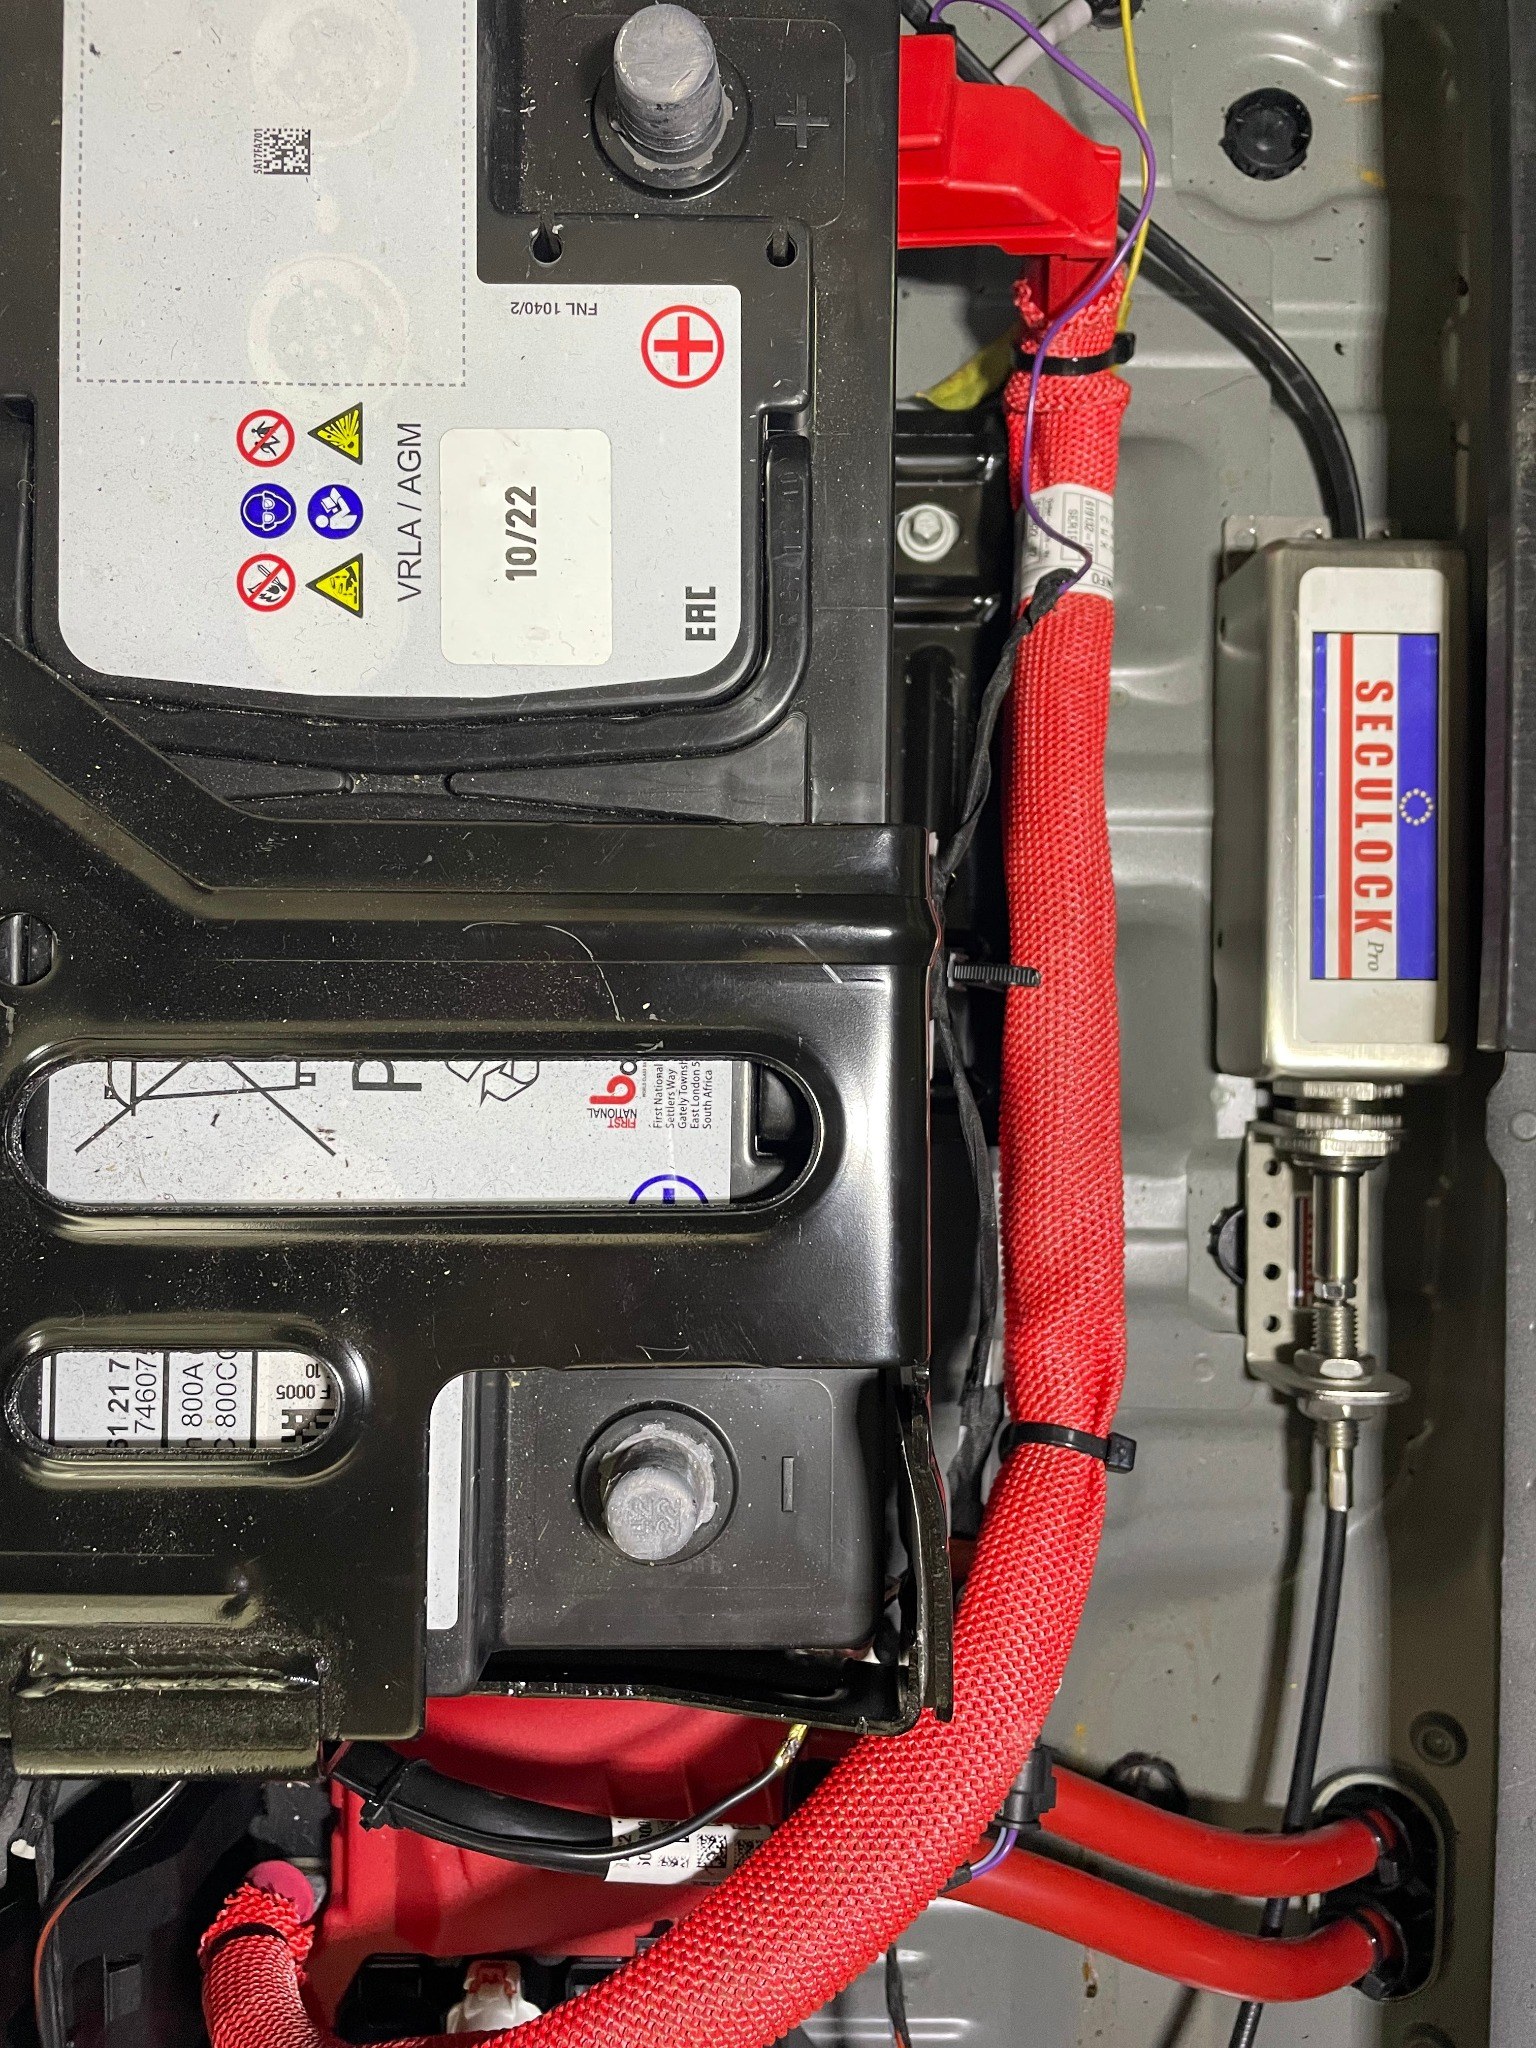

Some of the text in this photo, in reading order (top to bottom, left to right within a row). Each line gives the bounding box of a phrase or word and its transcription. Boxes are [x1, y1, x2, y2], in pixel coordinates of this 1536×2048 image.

[253, 128, 263, 175] 5A17FA701
[510, 301, 598, 316] FNL 1040/2
[397, 423, 422, 496] AGM
[504, 485, 537, 582] 10/22
[397, 518, 422, 603] VRLA
[685, 585, 717, 642] EAC
[1354, 679, 1393, 972] SECULOCK Pro
[653, 1064, 663, 1129] First National
[665, 1068, 679, 1129] Settlers Way
[690, 1069, 700, 1107] London
[702, 1070, 713, 1129] South Africa
[586, 1108, 638, 1119] NATIONAL
[607, 1118, 636, 1129] FIRST
[678, 1097, 691, 1129] Gately
[690, 1109, 700, 1129] East
[108, 1358, 130, 1373] 7
[107, 1386, 130, 1413] 21
[181, 1362, 204, 1427] 800A
[276, 1384, 316, 1400] 0005
